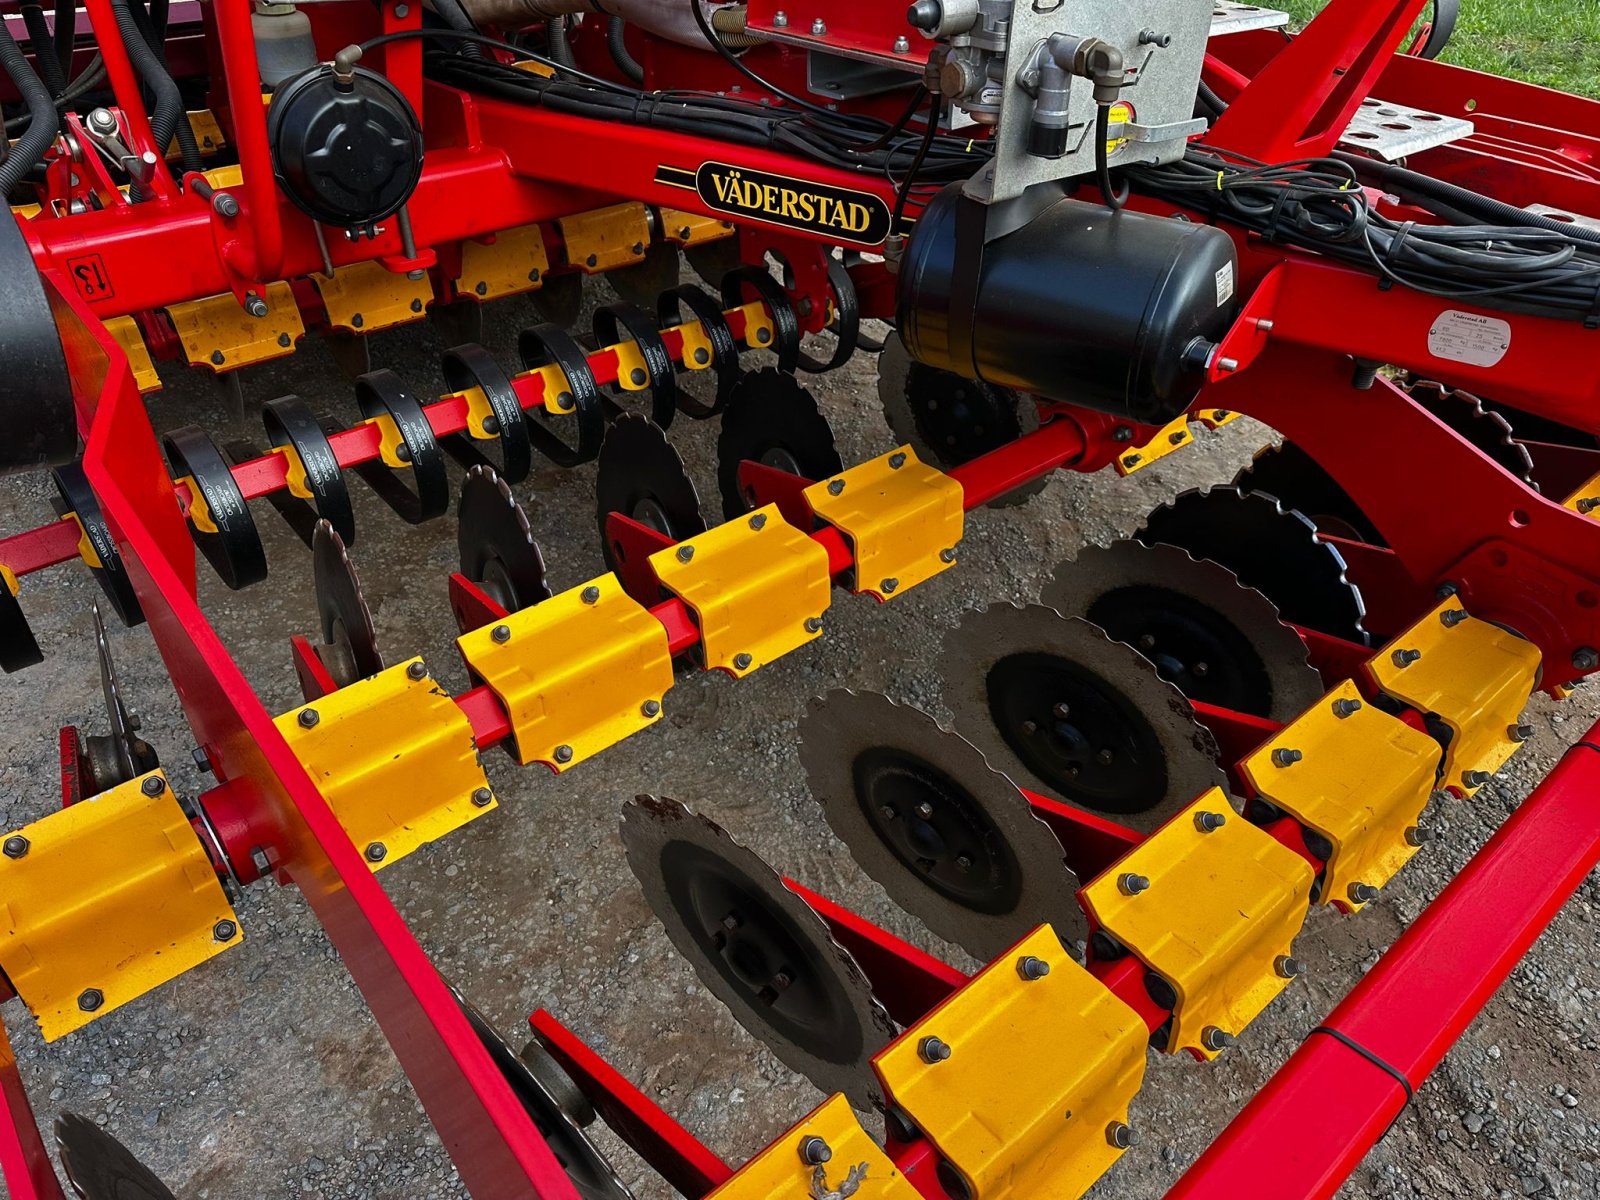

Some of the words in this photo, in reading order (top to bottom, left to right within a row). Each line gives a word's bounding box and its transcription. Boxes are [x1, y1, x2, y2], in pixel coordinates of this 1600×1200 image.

[711, 170, 870, 233] VÄDERSTAD
[205, 487, 224, 519] VÄDERSTAD
[213, 483, 234, 516] CROSSBOARD
